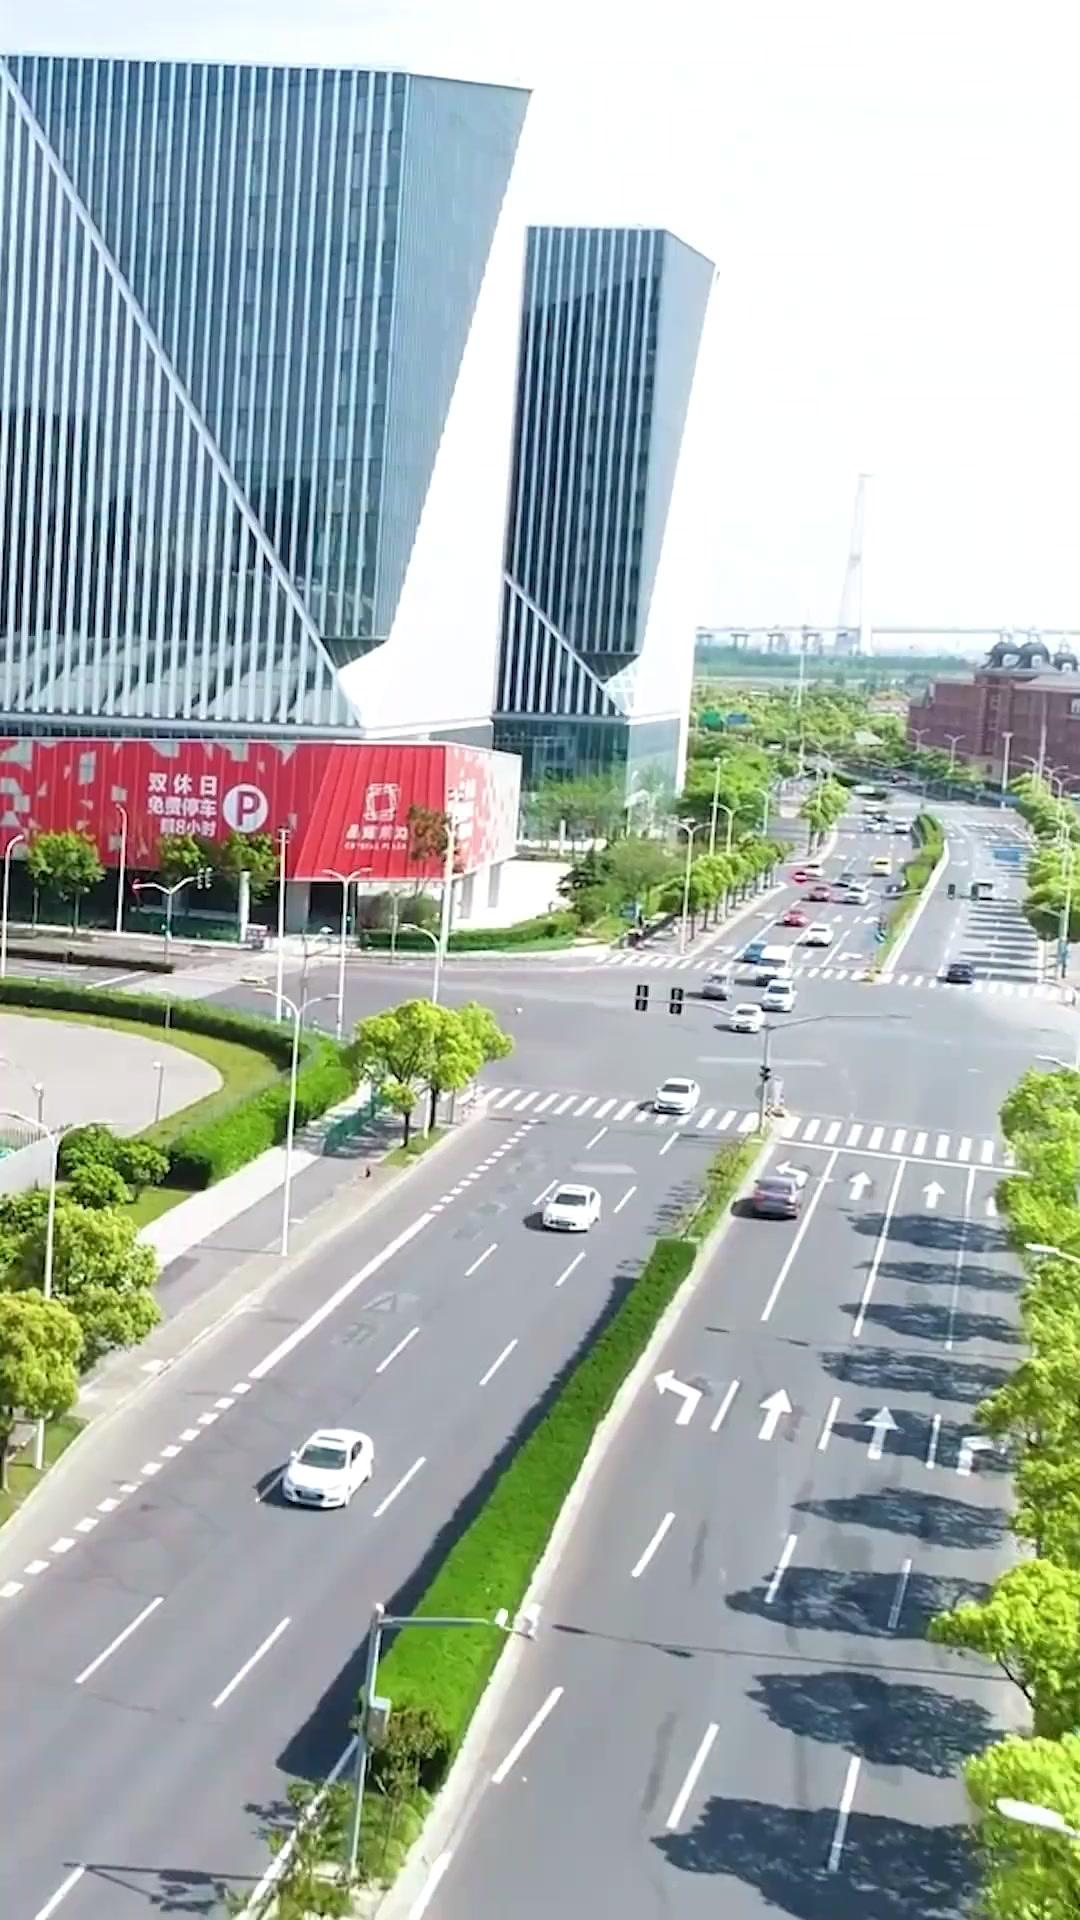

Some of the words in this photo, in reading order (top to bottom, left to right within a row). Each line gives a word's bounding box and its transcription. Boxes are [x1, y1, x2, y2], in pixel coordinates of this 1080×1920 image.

[148, 772, 217, 795] 双休日
[147, 796, 217, 818] 免费停车
[237, 791, 260, 826] P
